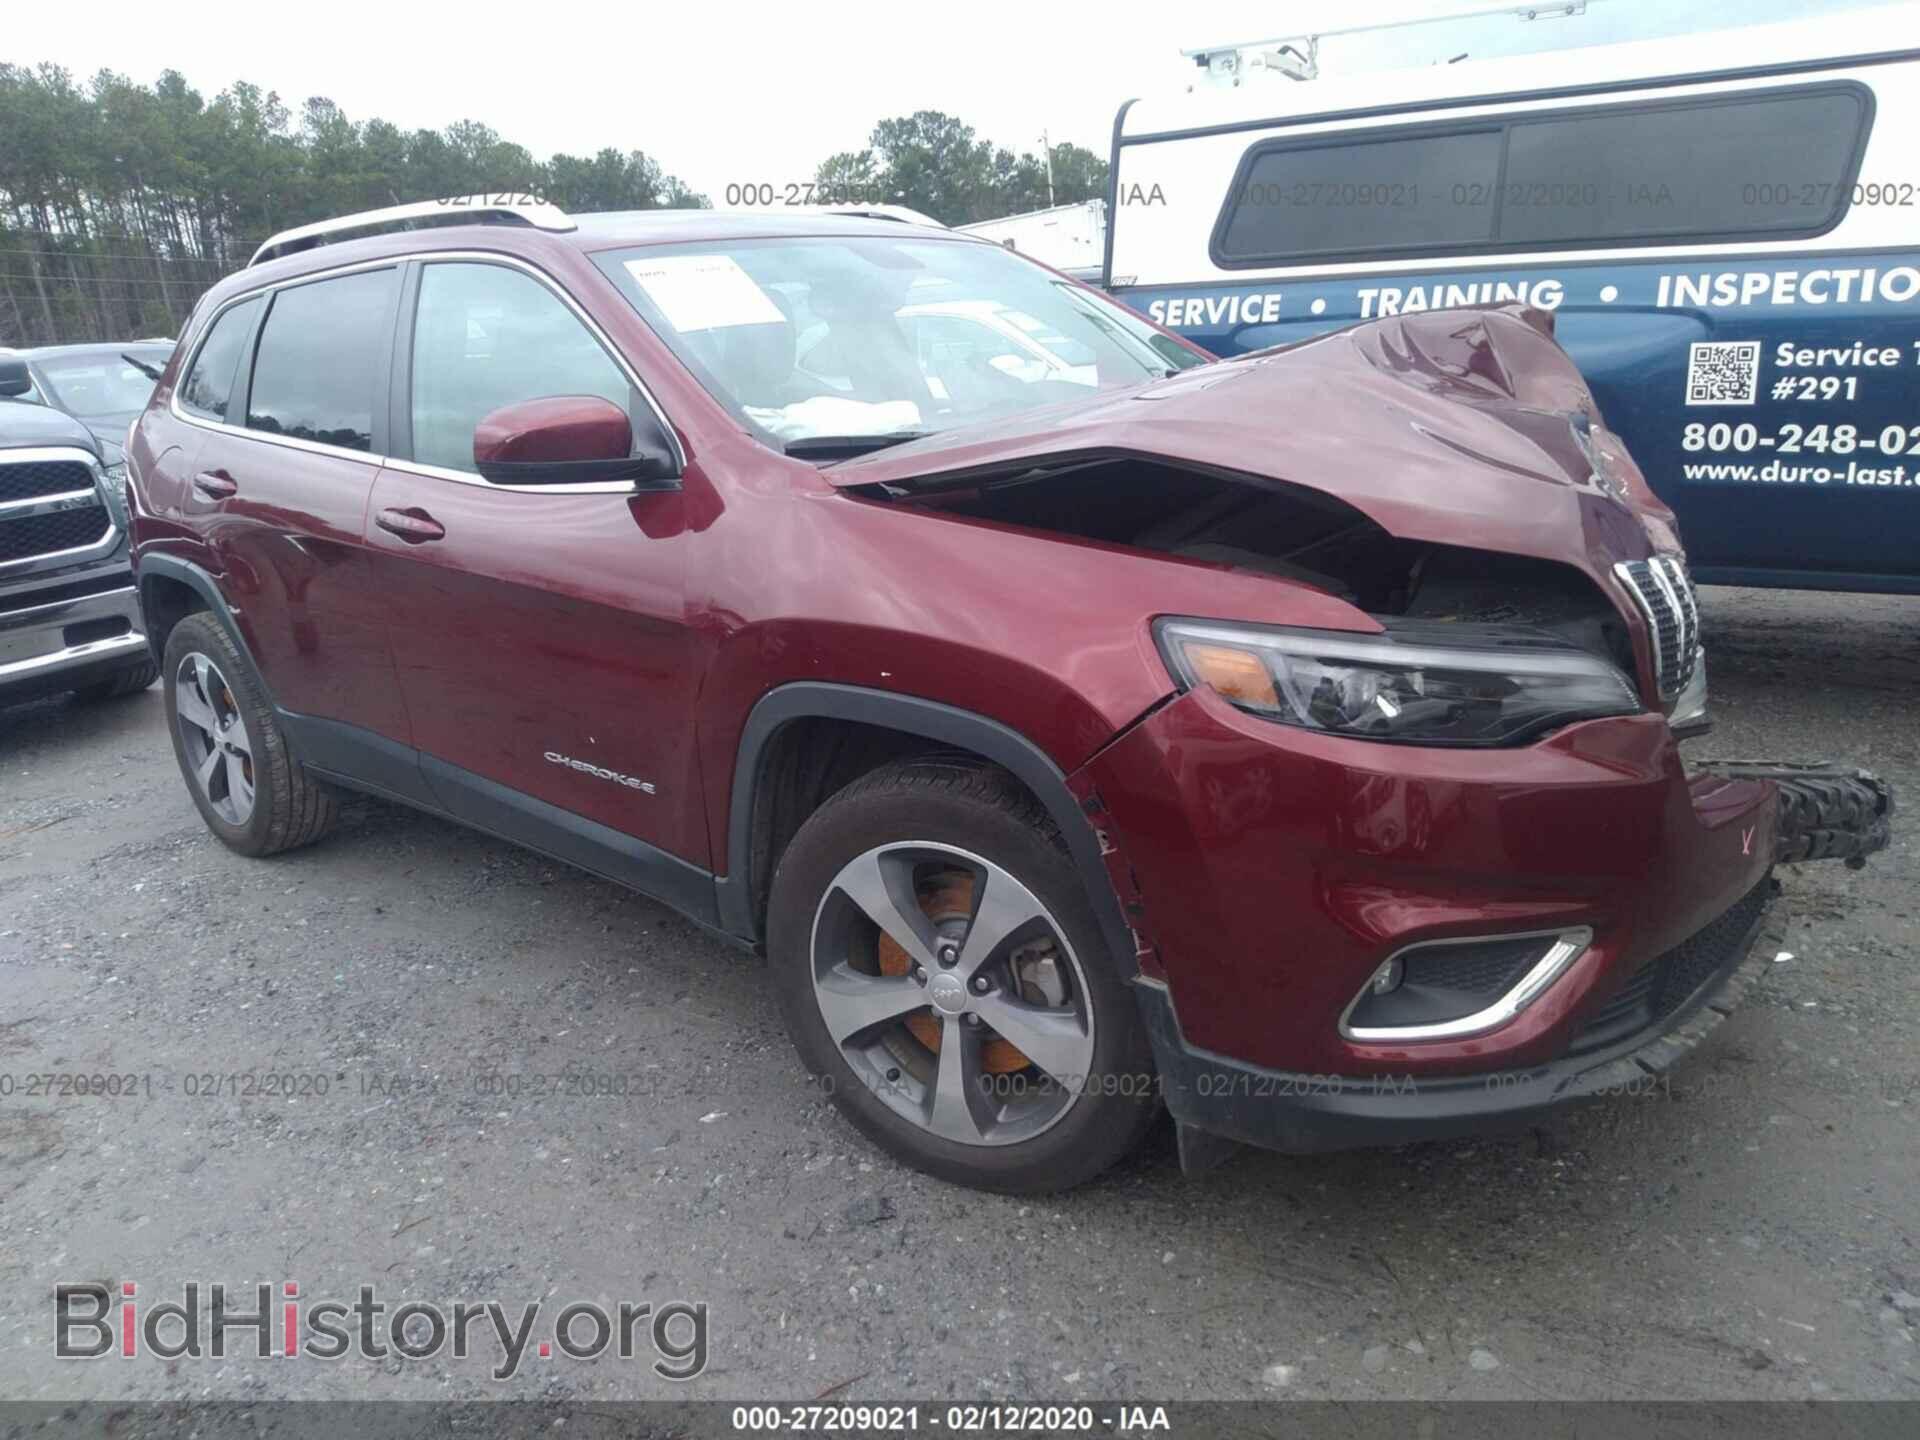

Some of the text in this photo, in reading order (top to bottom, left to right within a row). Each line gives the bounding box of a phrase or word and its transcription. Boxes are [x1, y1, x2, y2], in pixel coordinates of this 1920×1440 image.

[1148, 266, 1920, 327] SERVICE TRAINING INSPECTIO
[1774, 341, 1901, 368] Service
[1770, 376, 1858, 401] #291
[1683, 459, 1920, 487] www.duro-last.
[543, 751, 657, 795] CHEROKEE
